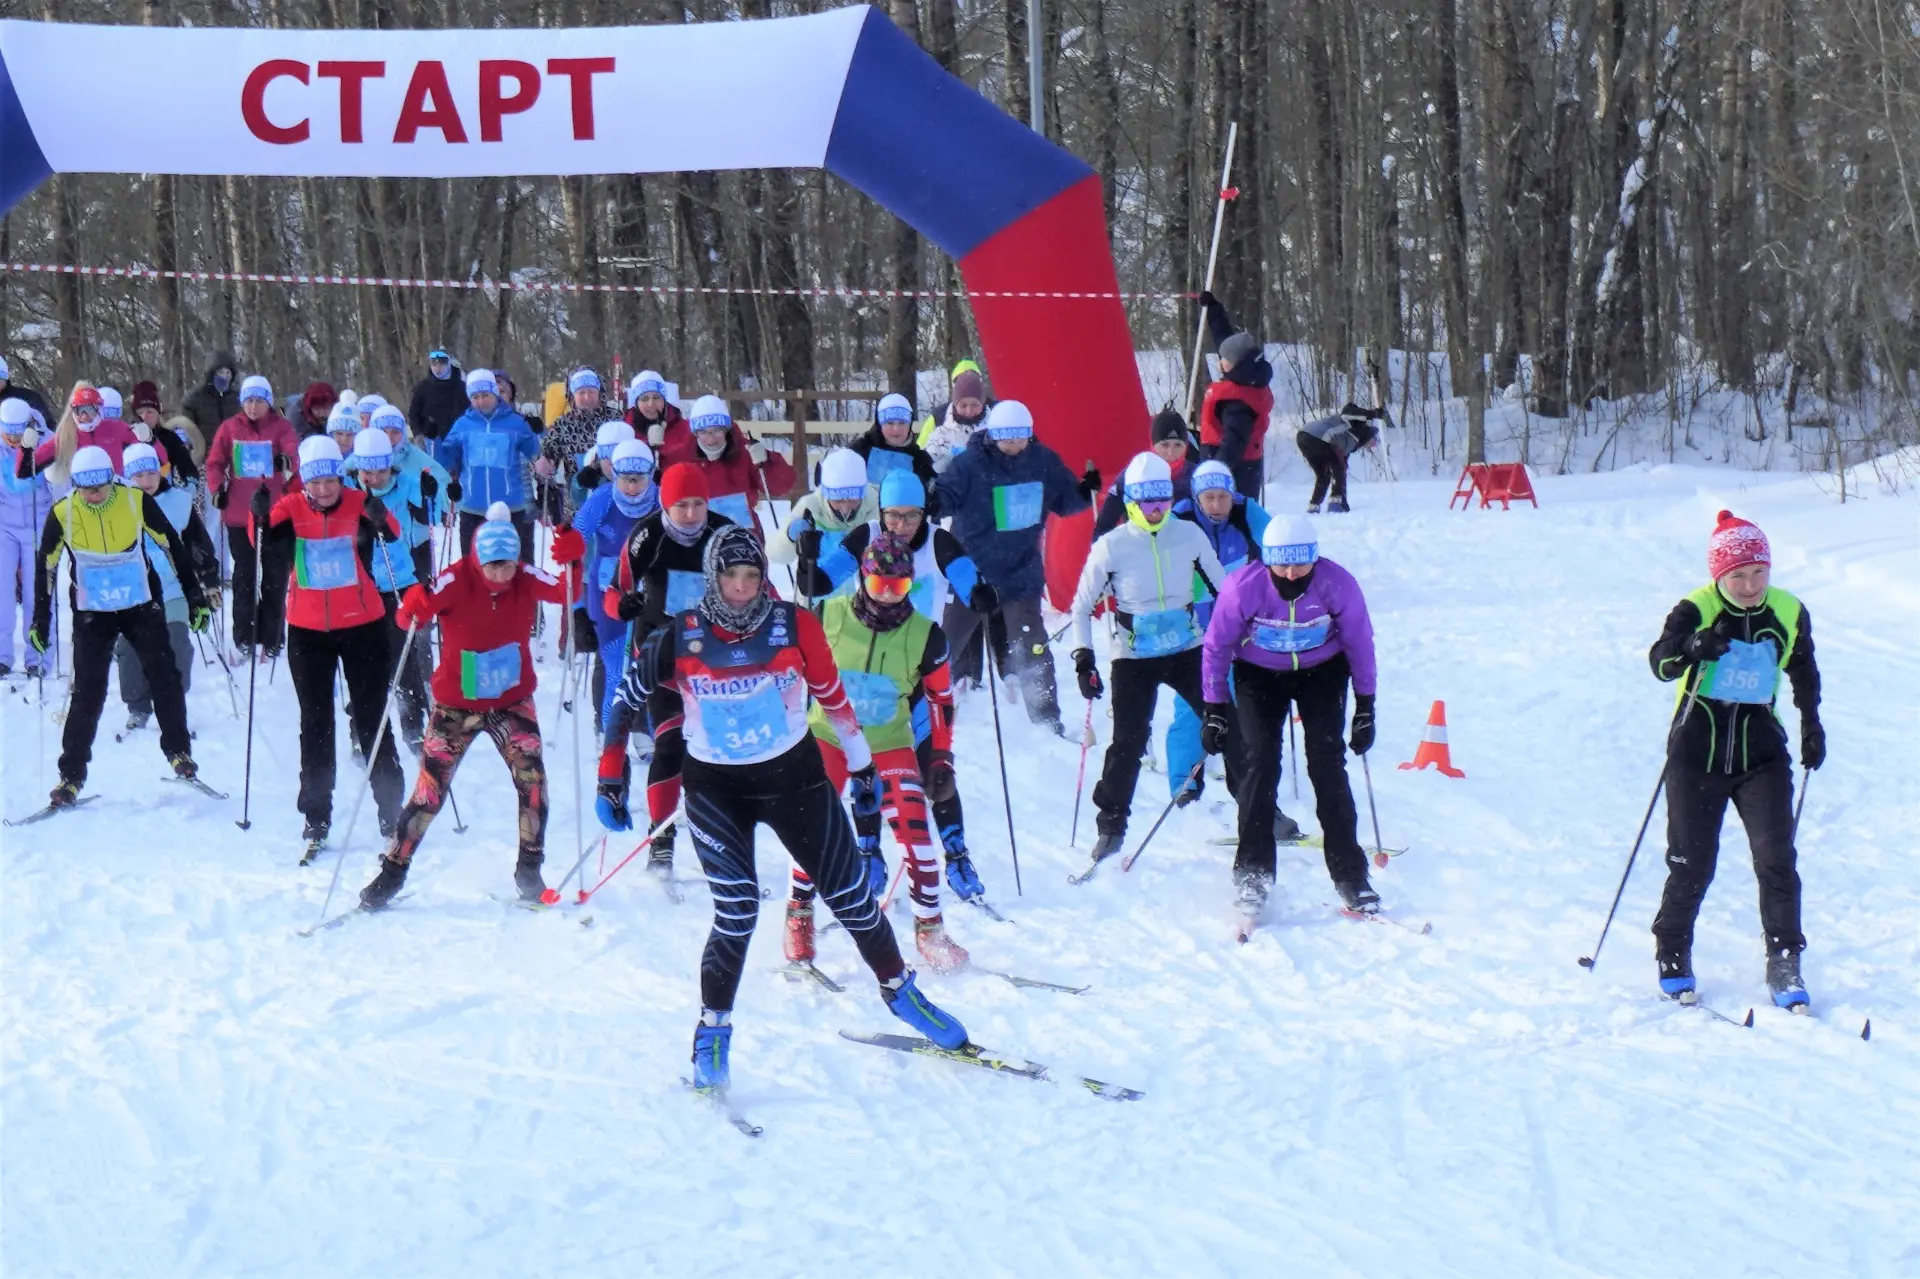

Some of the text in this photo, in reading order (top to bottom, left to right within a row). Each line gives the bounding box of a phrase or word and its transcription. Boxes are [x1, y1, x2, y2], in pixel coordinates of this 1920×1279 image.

[241, 57, 616, 145] СТАРТ
[100, 586, 131, 602] 347
[1722, 669, 1760, 690] 356
[725, 723, 772, 750] 341
